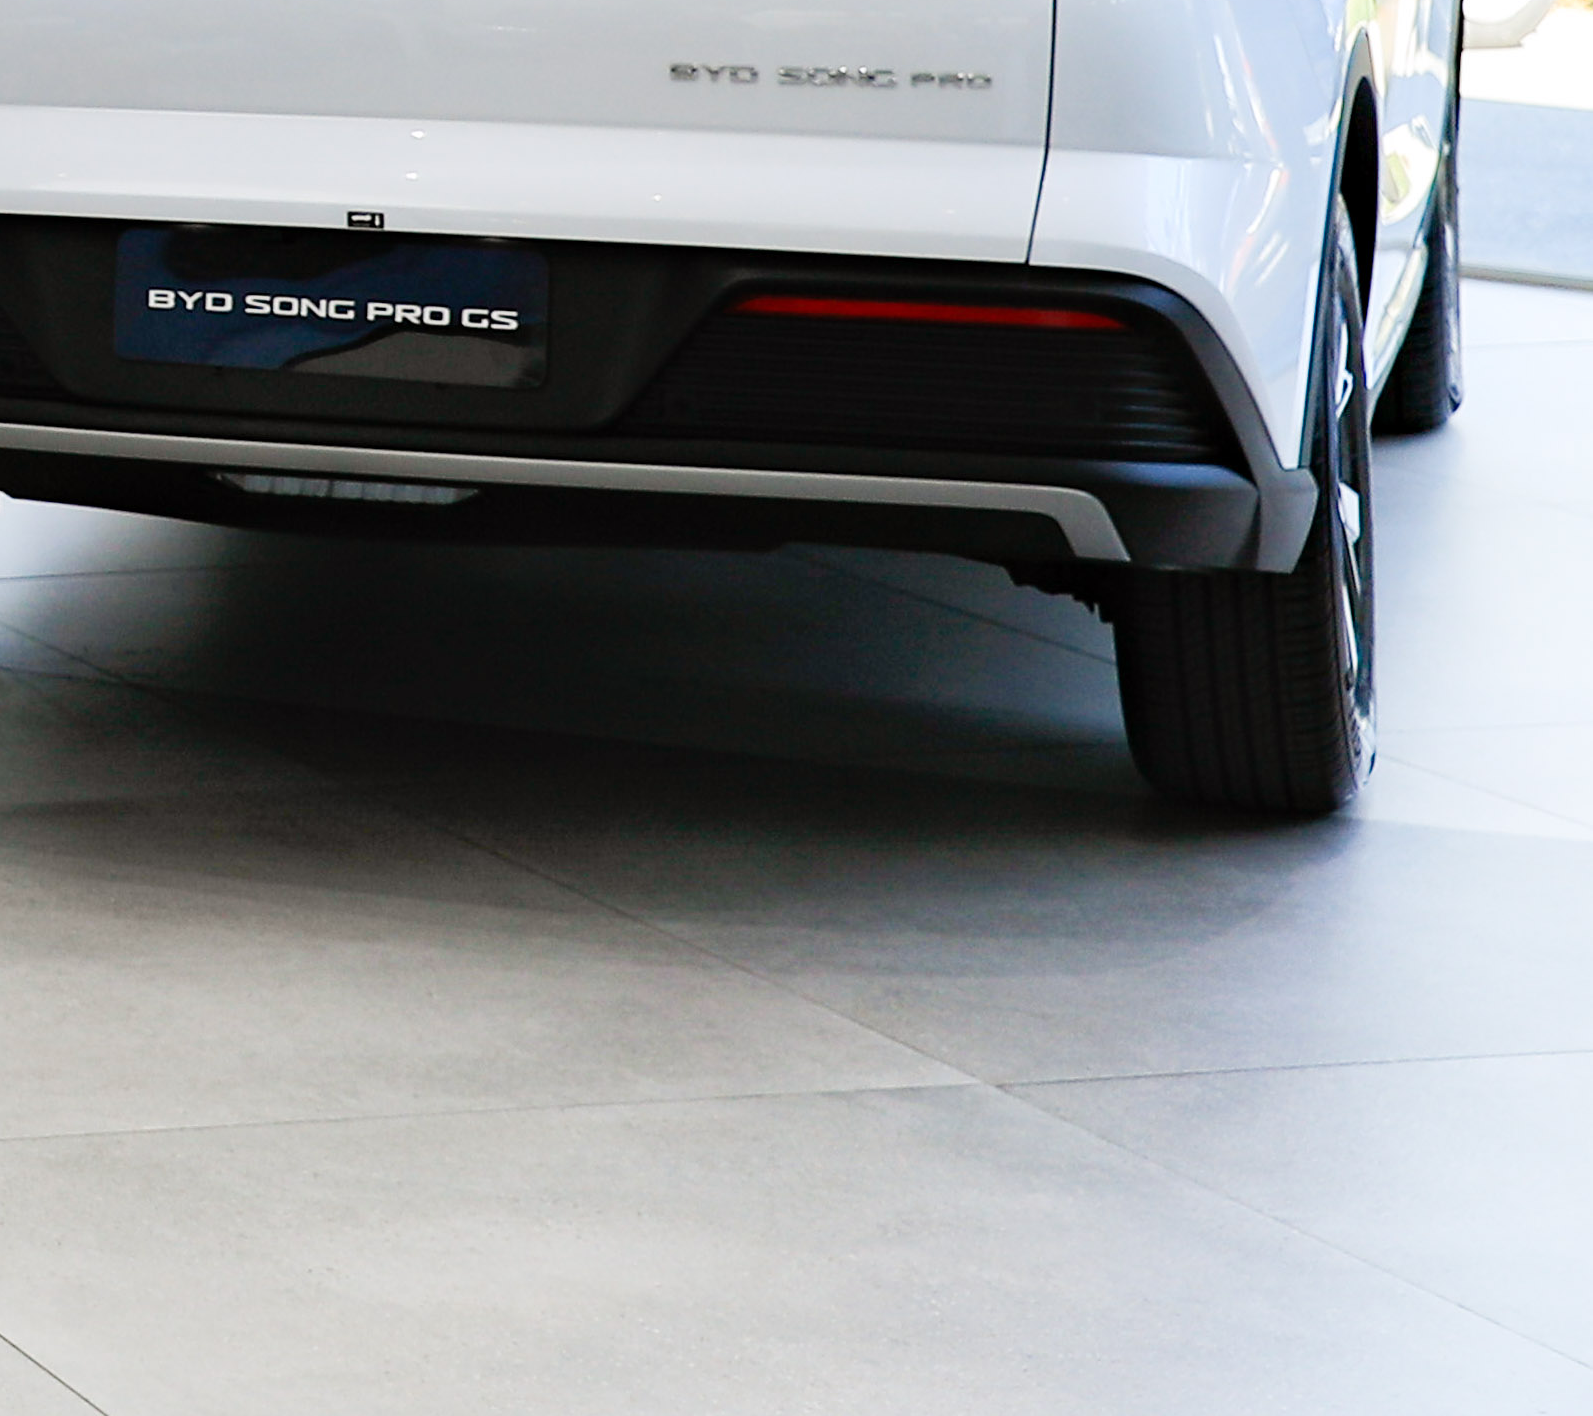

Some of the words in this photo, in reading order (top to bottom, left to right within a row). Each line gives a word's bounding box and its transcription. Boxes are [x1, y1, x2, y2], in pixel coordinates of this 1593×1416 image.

[670, 63, 759, 84] BYD
[778, 65, 898, 88] SONG
[910, 71, 993, 88] PRO
[148, 289, 233, 312] BYD
[244, 294, 356, 320] SONG
[366, 302, 451, 326] PRO
[461, 308, 519, 331] GS
